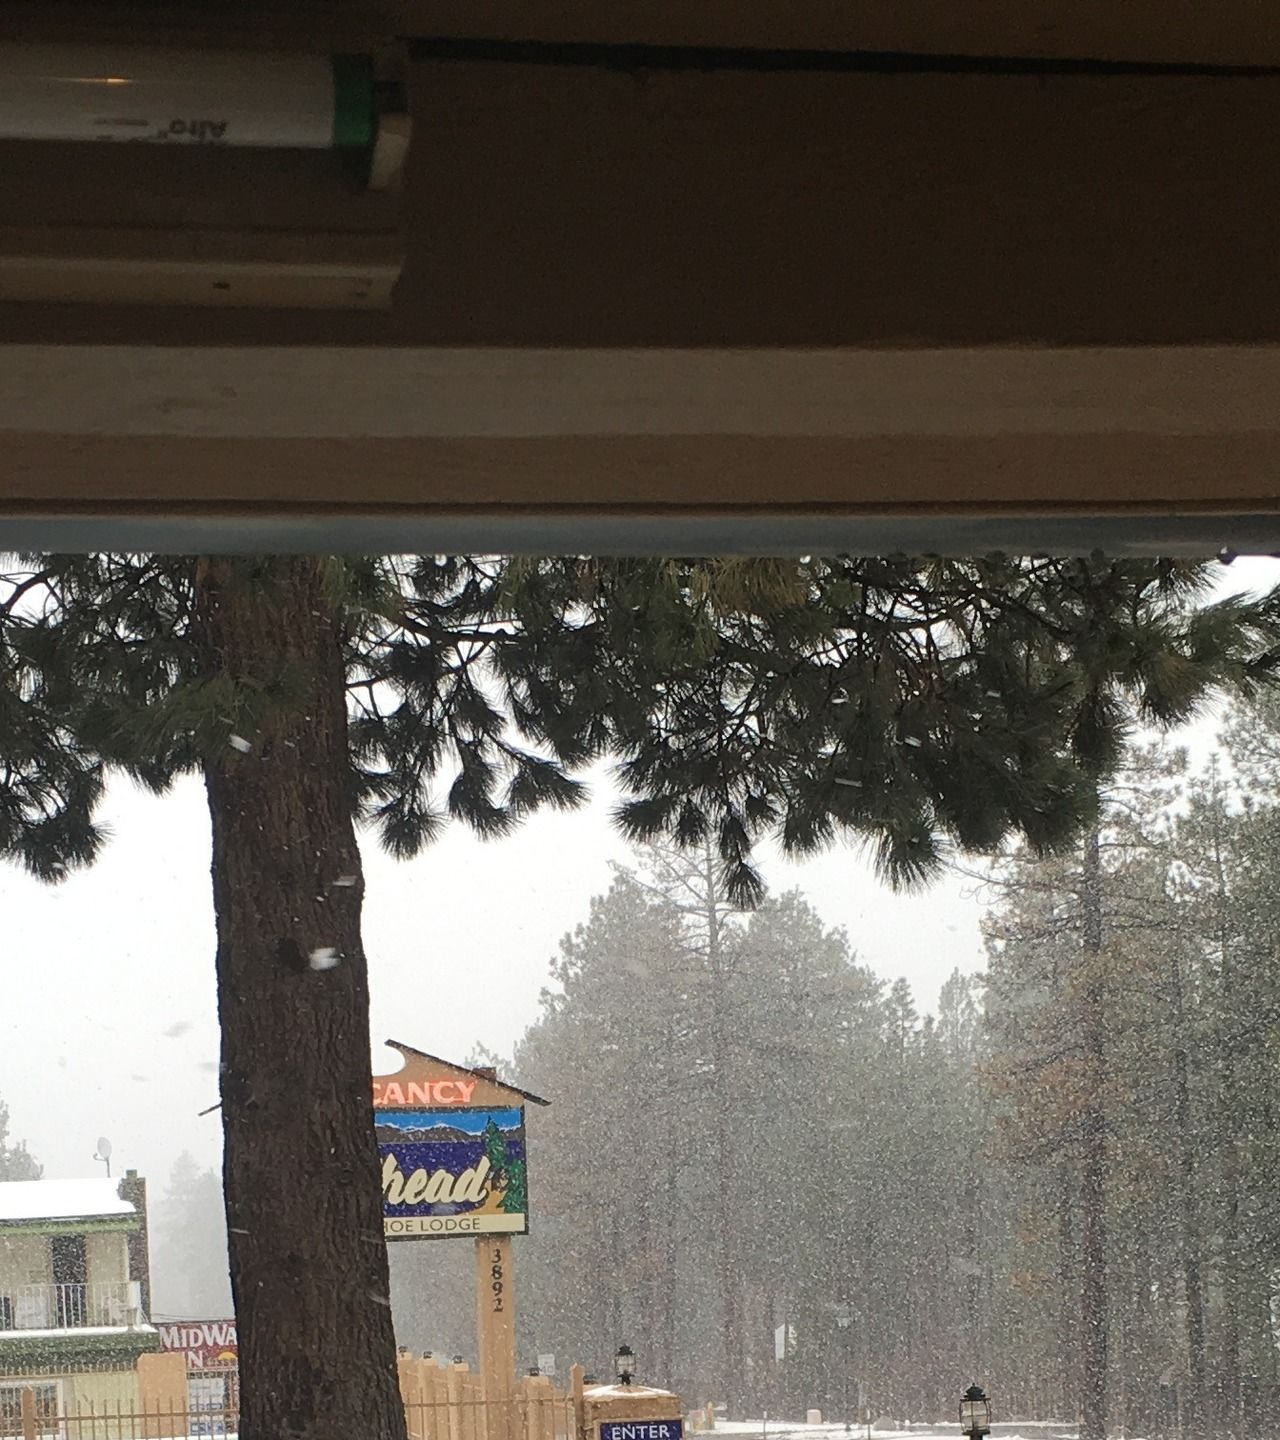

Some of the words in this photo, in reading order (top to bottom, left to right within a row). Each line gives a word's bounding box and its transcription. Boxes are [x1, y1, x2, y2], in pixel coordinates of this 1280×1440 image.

[420, 1217, 480, 1232] LODGE
[491, 1248, 503, 1313] 3892
[611, 1424, 670, 1440] ENTER
